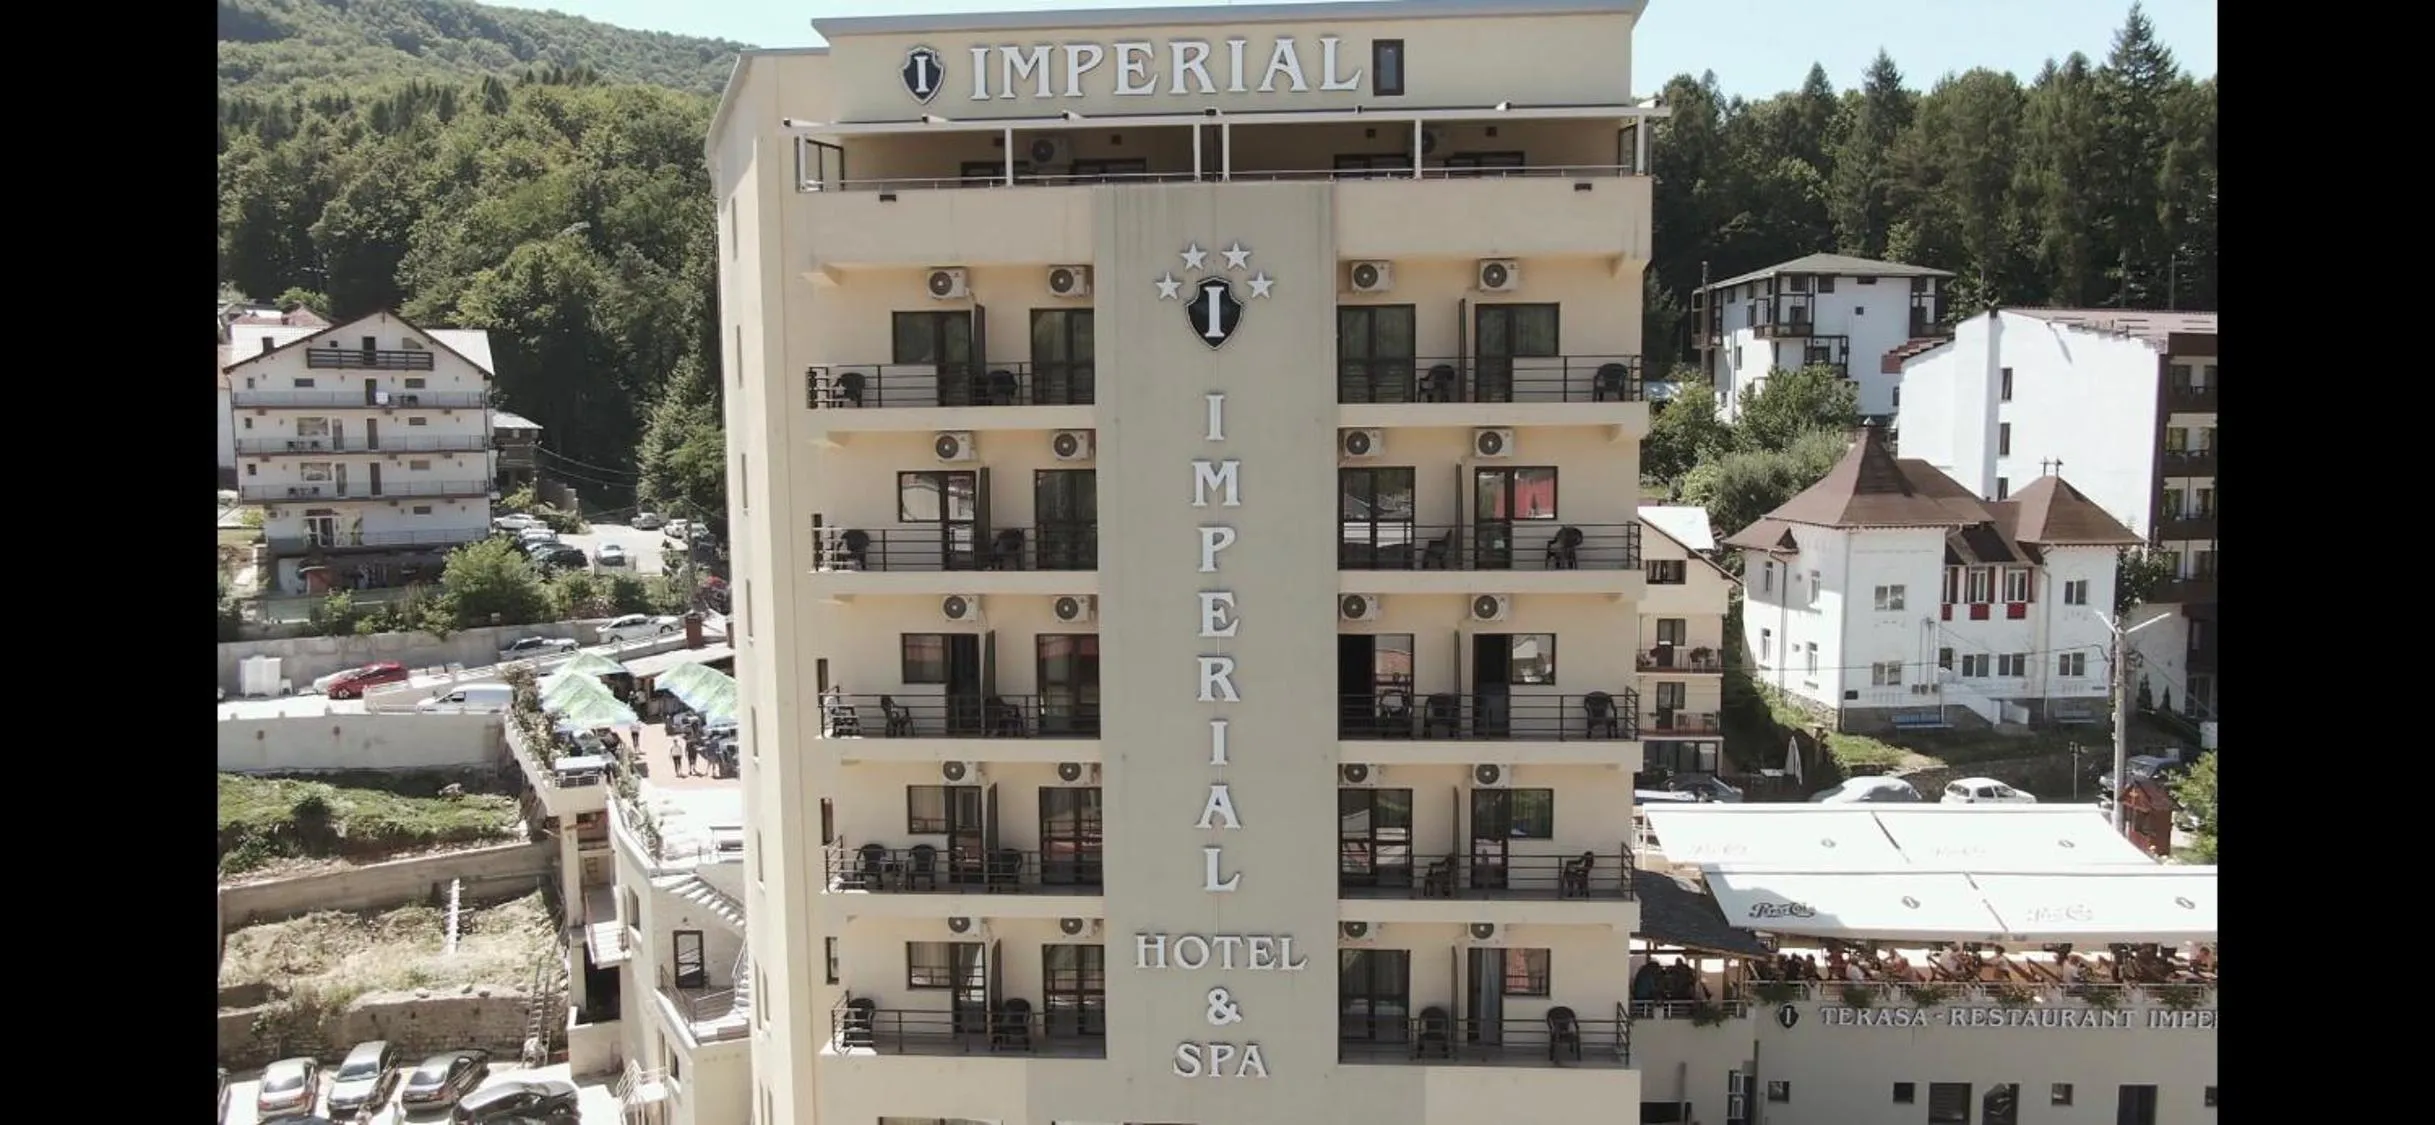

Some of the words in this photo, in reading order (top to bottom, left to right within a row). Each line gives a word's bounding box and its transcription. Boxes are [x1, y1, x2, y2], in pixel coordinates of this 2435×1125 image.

[970, 37, 1362, 100] IMPERIAL
[1191, 394, 1241, 892] IMPERIAL
[1134, 933, 1309, 971] HOTEL
[1207, 987, 1242, 1025] &
[1820, 1006, 1928, 1027] TERASA
[1950, 1007, 2136, 1028] RESTAURANT
[2149, 1008, 2217, 1029] IMPE
[1172, 1042, 1269, 1079] SPA
